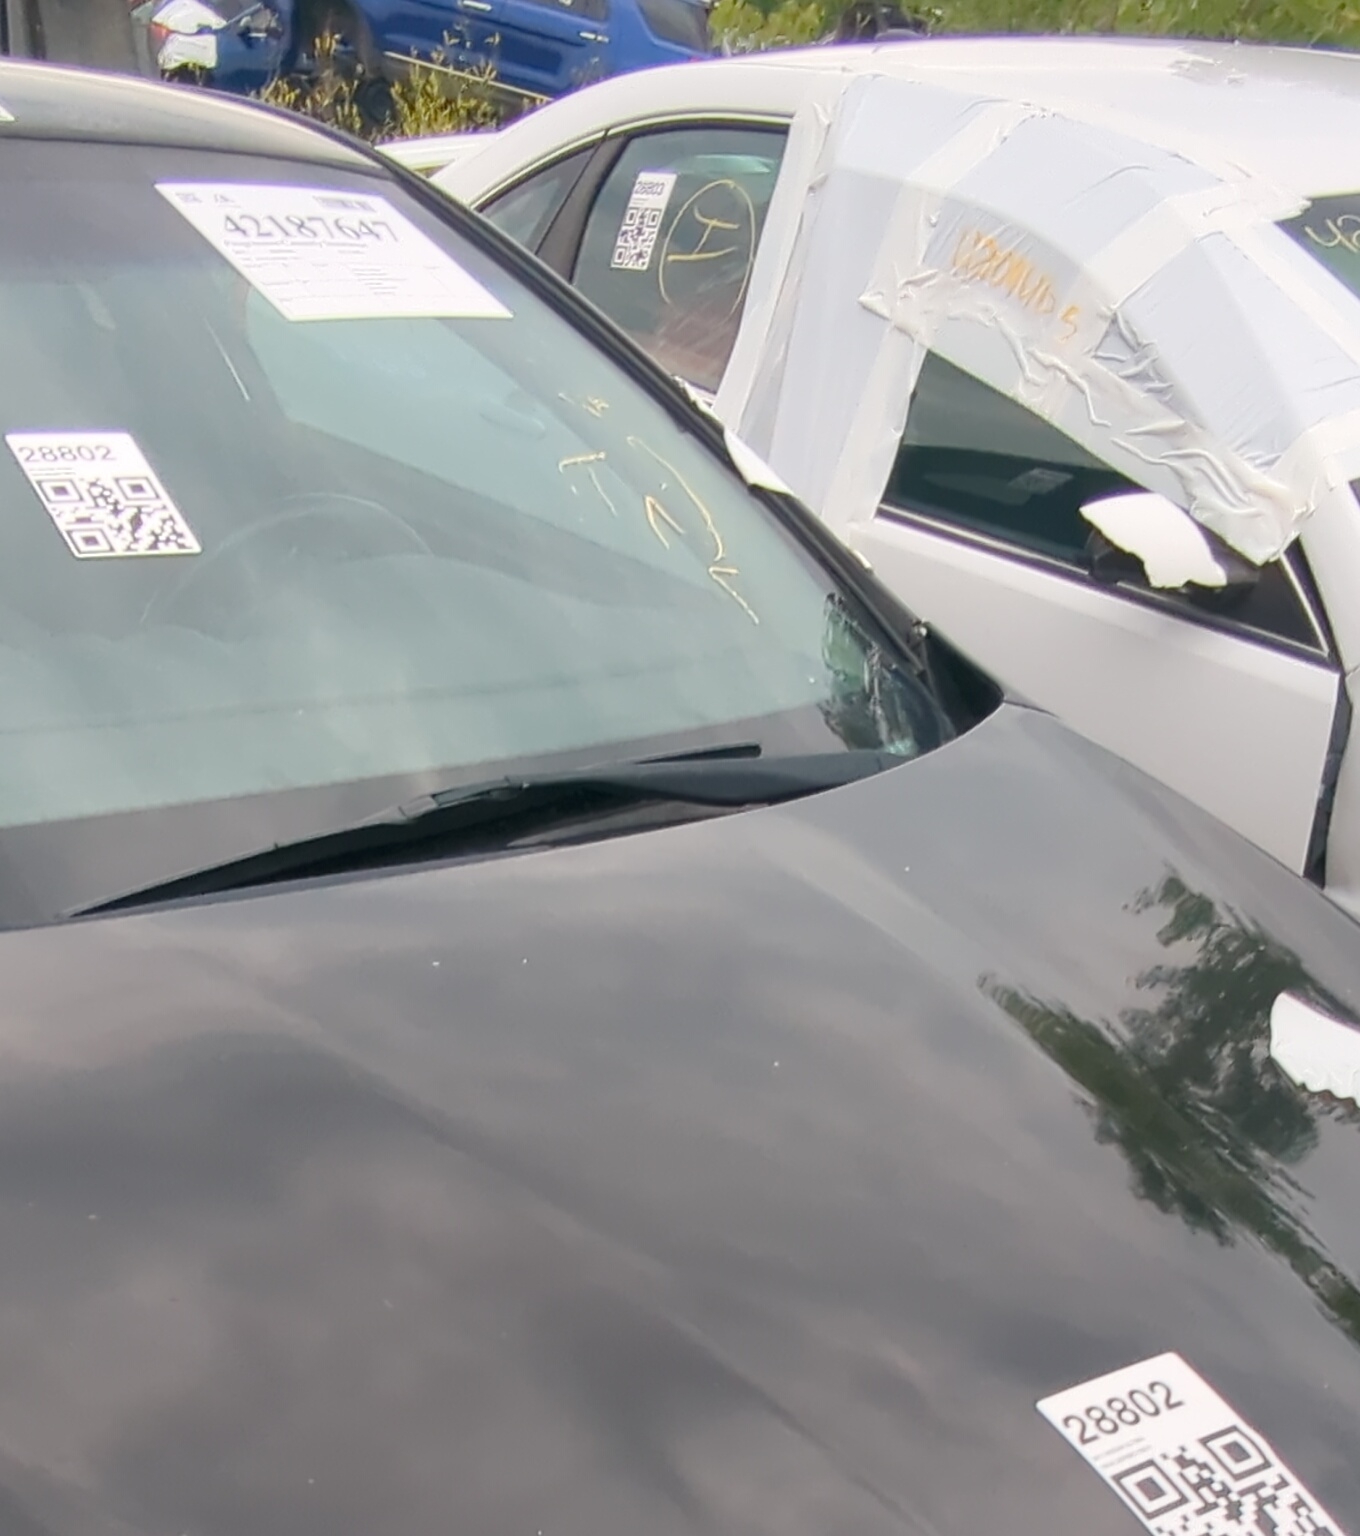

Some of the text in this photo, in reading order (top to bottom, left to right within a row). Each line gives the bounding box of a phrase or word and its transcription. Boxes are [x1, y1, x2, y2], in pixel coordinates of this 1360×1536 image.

[224, 214, 398, 242] 42187647
[18, 444, 117, 463] 28802
[1062, 1380, 1186, 1446] 28802
